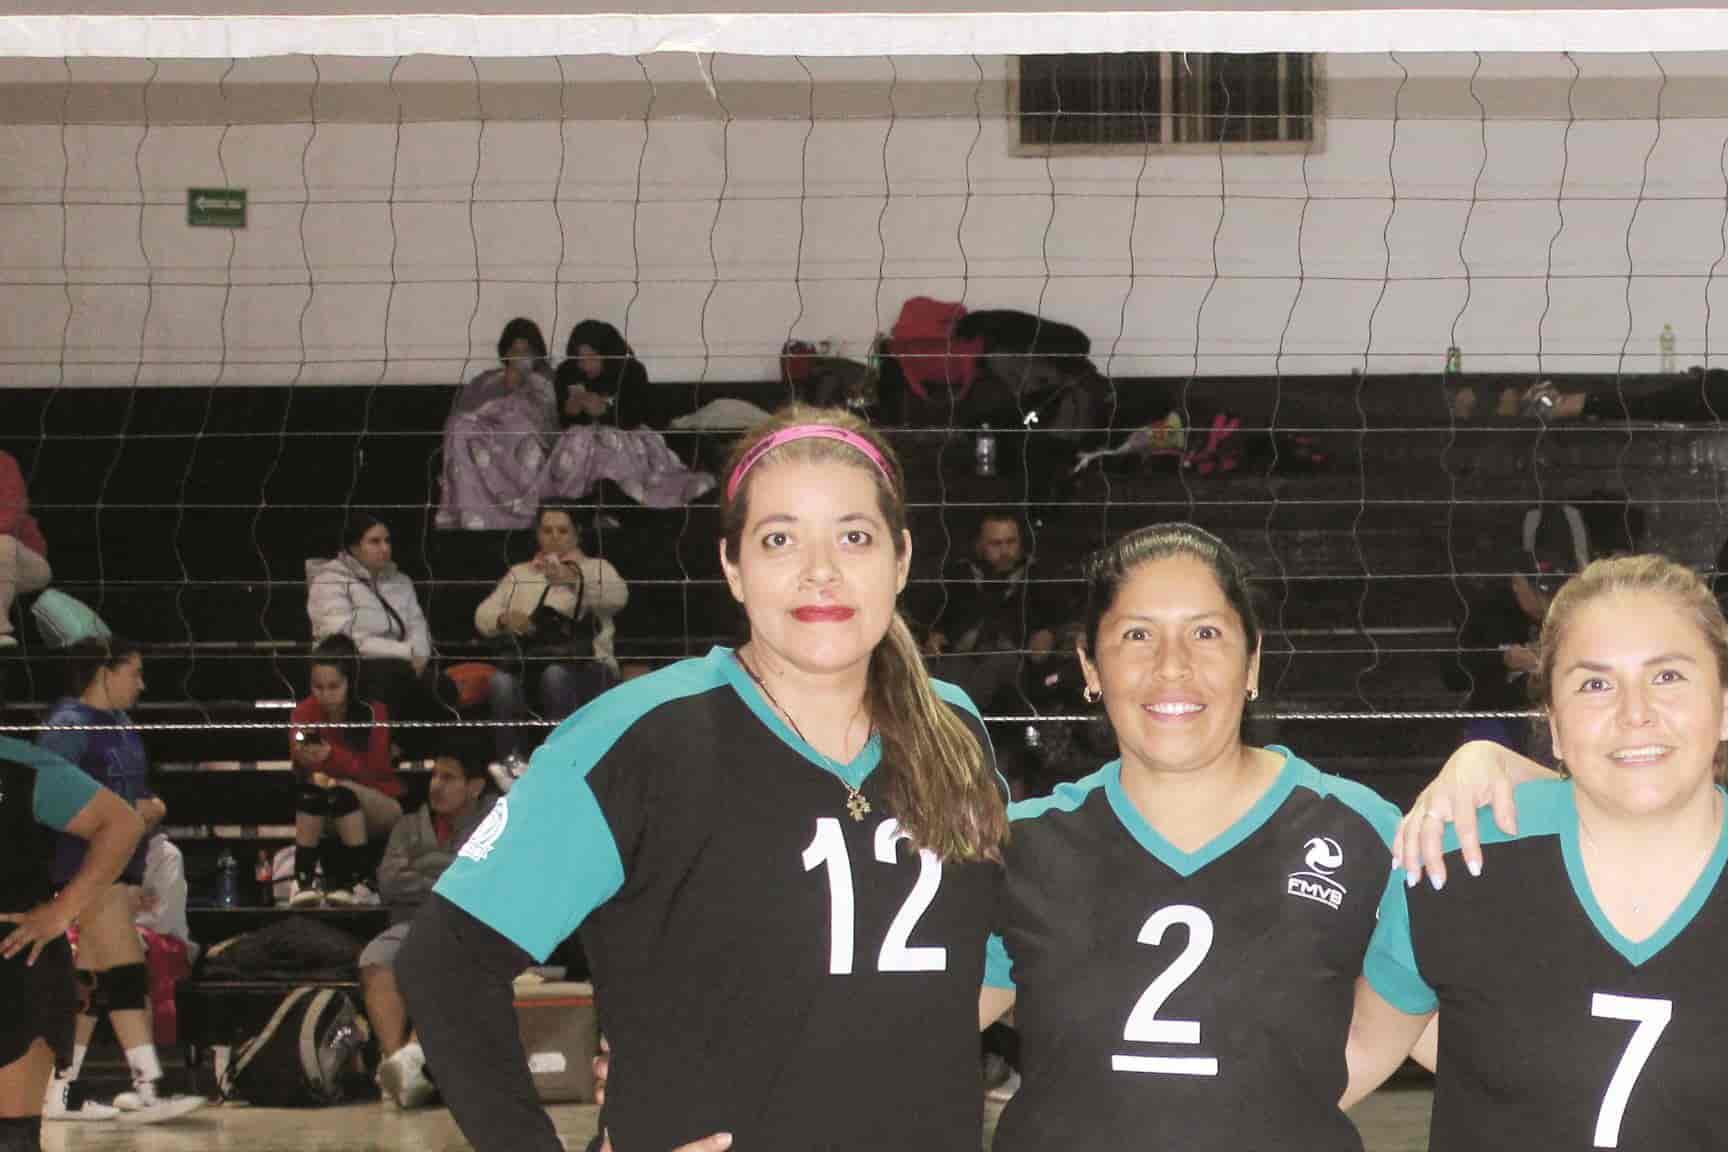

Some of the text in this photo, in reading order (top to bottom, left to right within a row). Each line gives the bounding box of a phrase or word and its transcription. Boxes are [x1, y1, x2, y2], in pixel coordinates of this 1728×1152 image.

[802, 817, 947, 975] 12
[1287, 877, 1343, 905] FMVB
[1123, 904, 1213, 1045] 2
[1591, 992, 1673, 1149] 7
